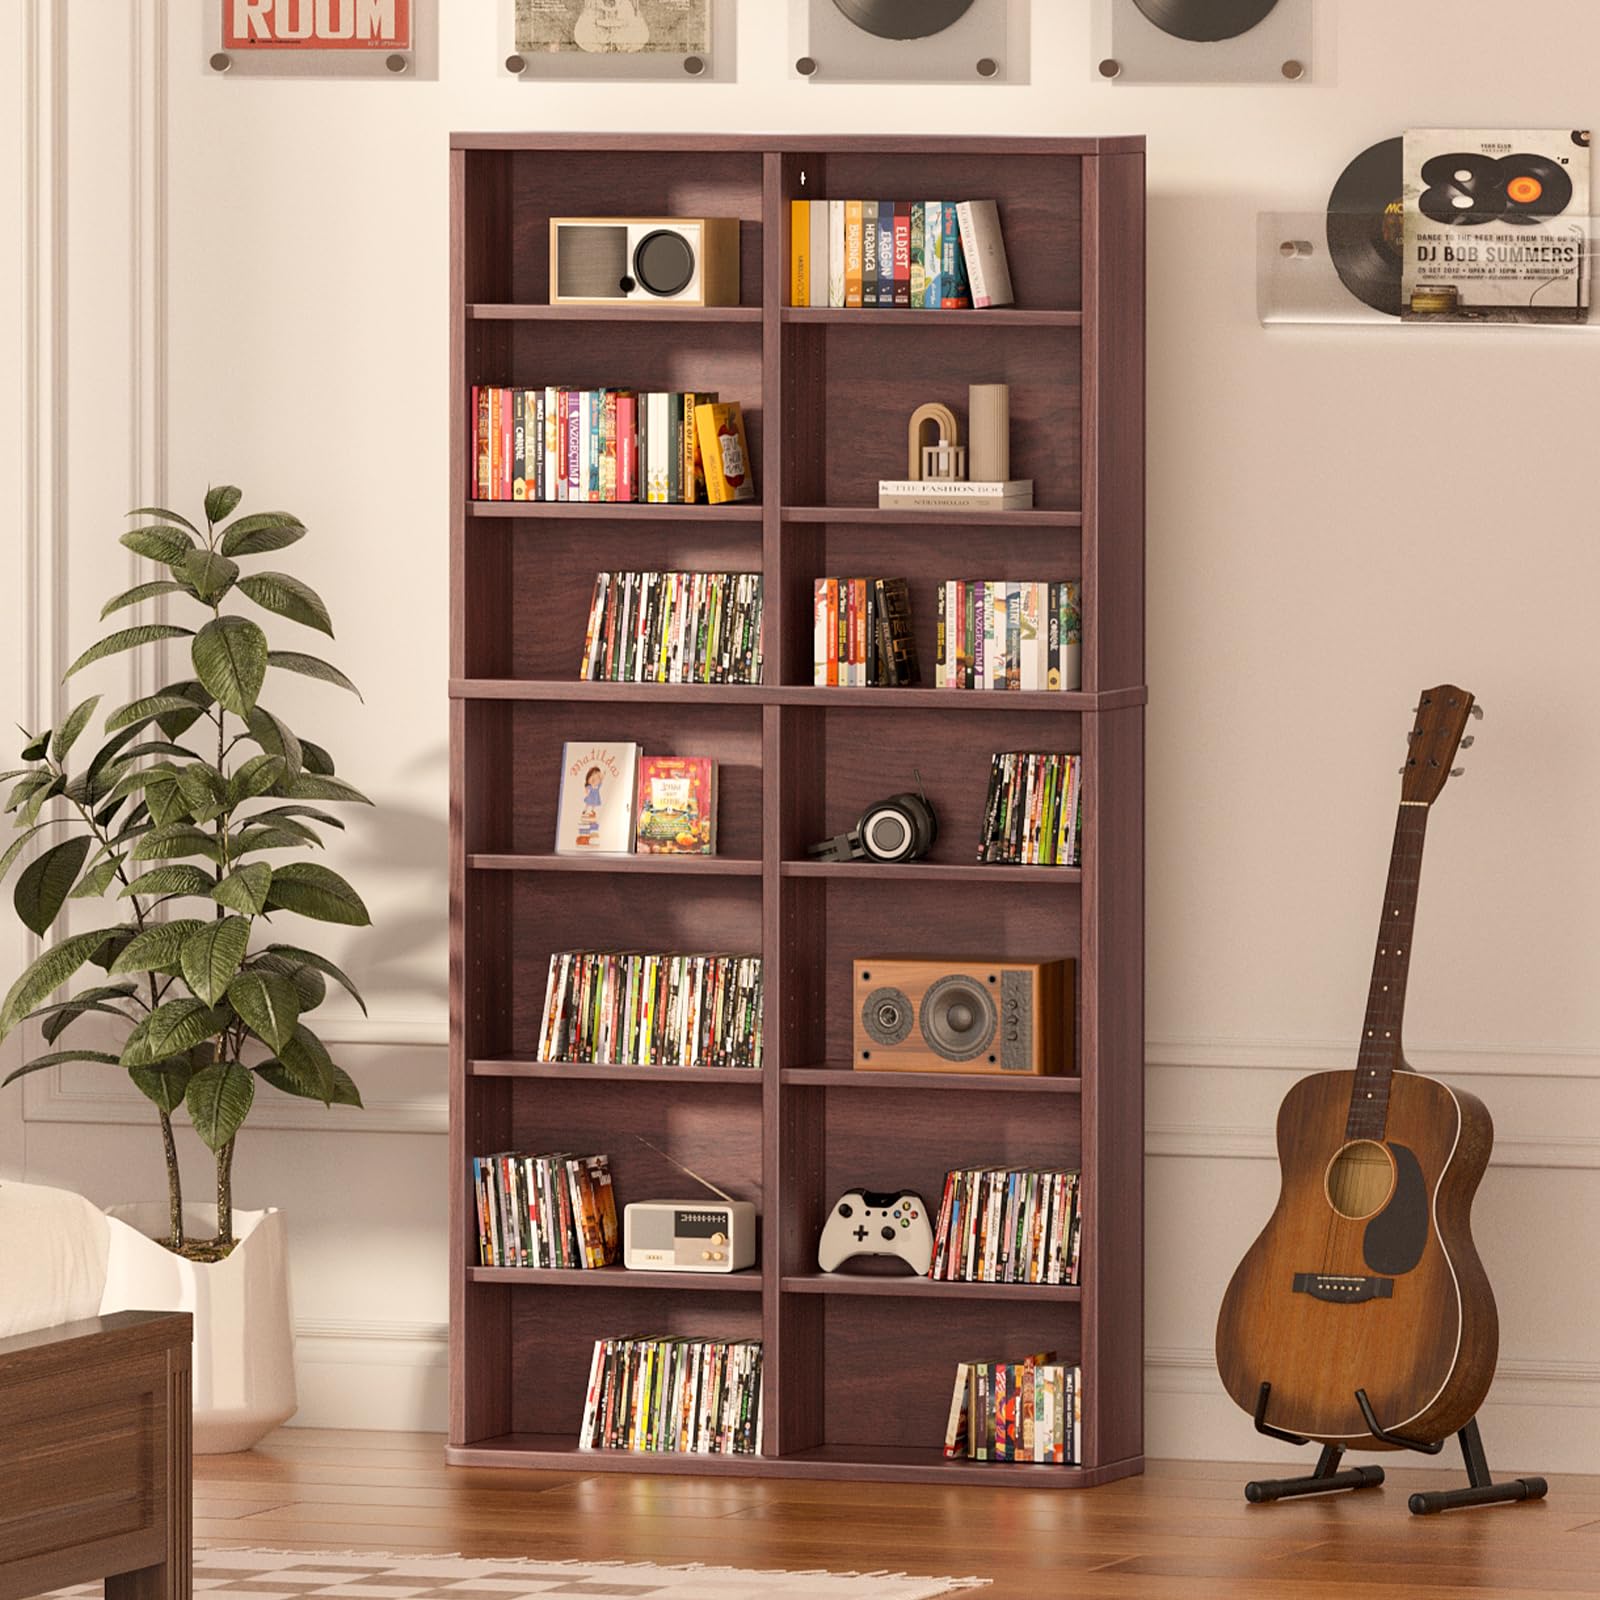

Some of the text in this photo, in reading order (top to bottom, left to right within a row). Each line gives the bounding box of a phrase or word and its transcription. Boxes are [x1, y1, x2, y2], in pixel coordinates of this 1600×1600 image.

[895, 226, 908, 269] ELDEST
[1417, 246, 1574, 263] DJ BOB SUMMERS
[686, 429, 693, 441] OF
[922, 483, 974, 492] FASHION
